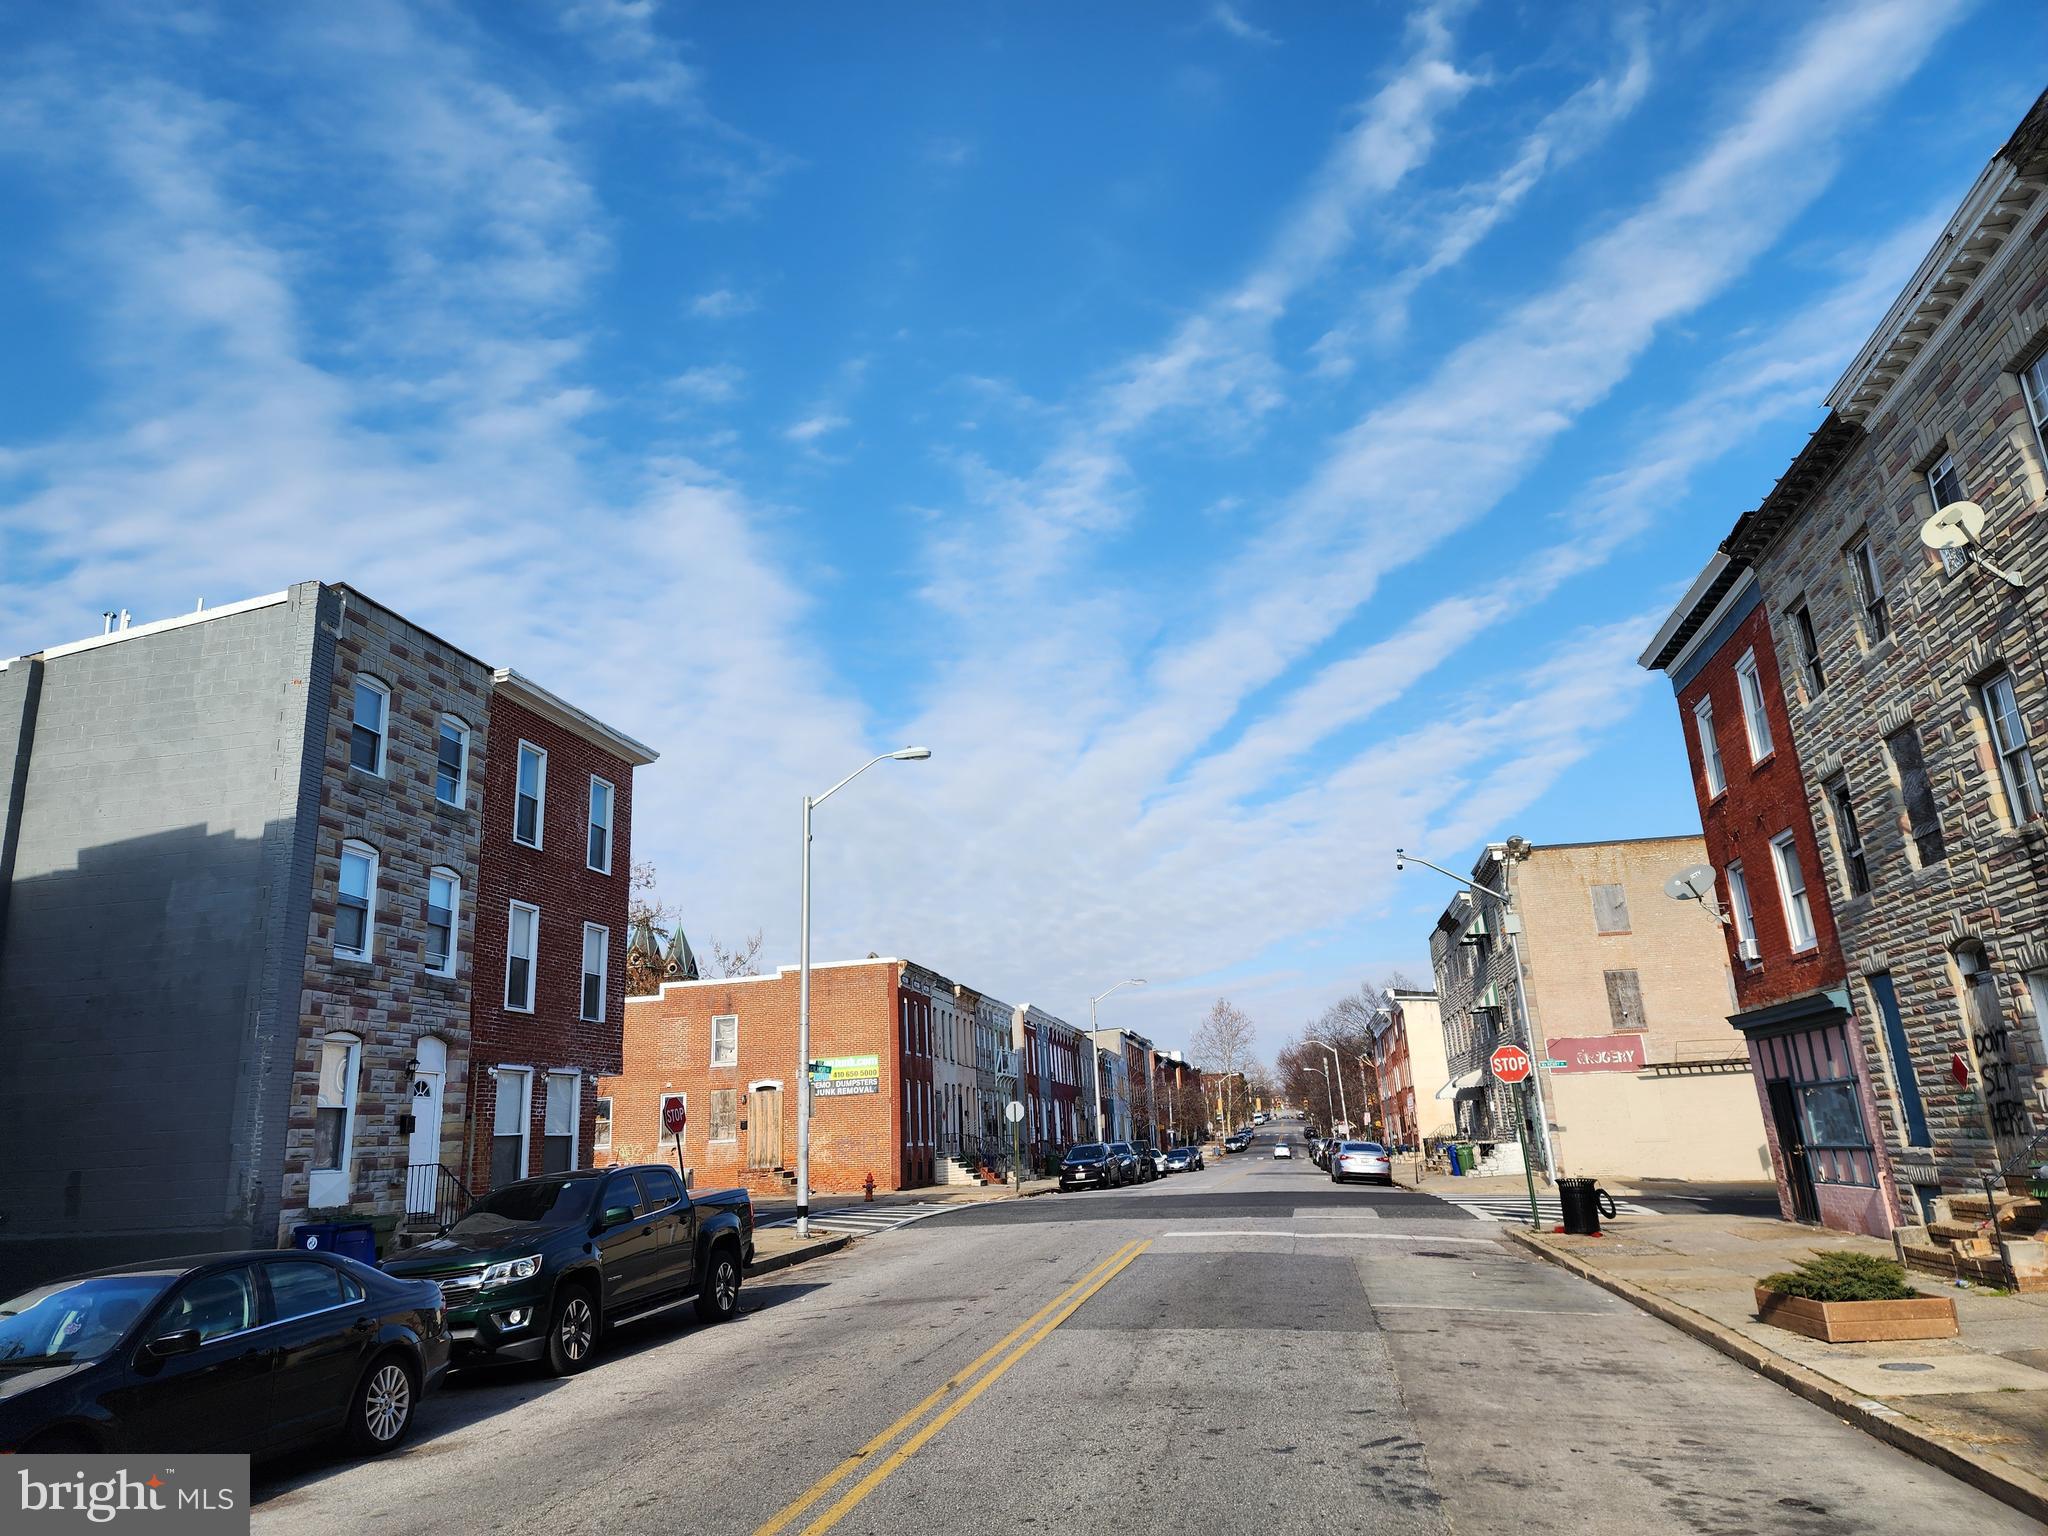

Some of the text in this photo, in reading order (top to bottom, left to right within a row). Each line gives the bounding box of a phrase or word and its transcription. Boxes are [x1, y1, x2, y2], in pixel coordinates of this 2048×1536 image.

[1493, 1056, 1527, 1073] STOP
[836, 1078, 877, 1087] DUMPSTERS
[1982, 1062, 2013, 1097] SIT
[815, 1086, 875, 1096] JUNK REMOVAL
[667, 1107, 684, 1123] STOP
[1990, 1100, 2029, 1138] HERE
